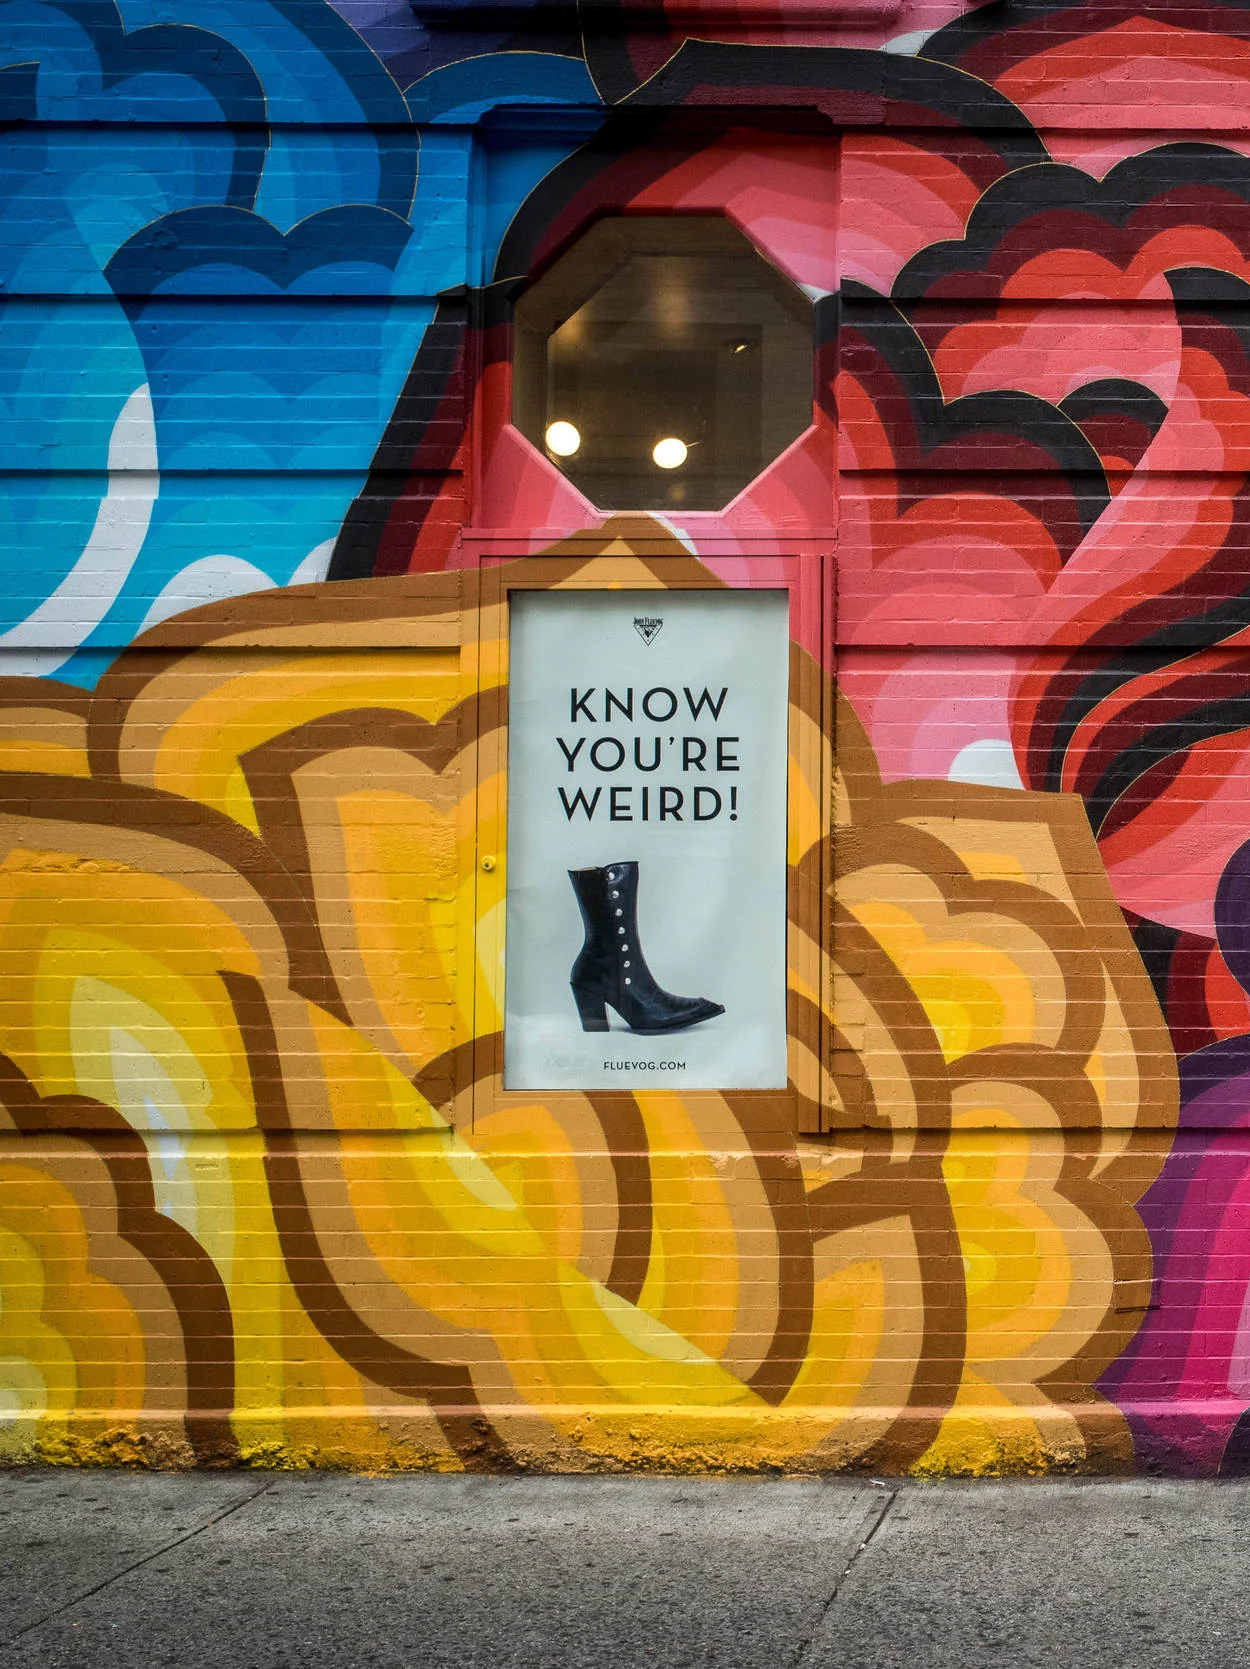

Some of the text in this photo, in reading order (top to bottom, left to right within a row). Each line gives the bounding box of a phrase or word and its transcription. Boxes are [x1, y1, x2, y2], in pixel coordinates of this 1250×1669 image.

[570, 686, 729, 723] KNOW
[555, 736, 740, 772] YOU'RE
[557, 786, 738, 822] WEIRD!
[603, 1061, 686, 1071] FLUEVOG.COM
